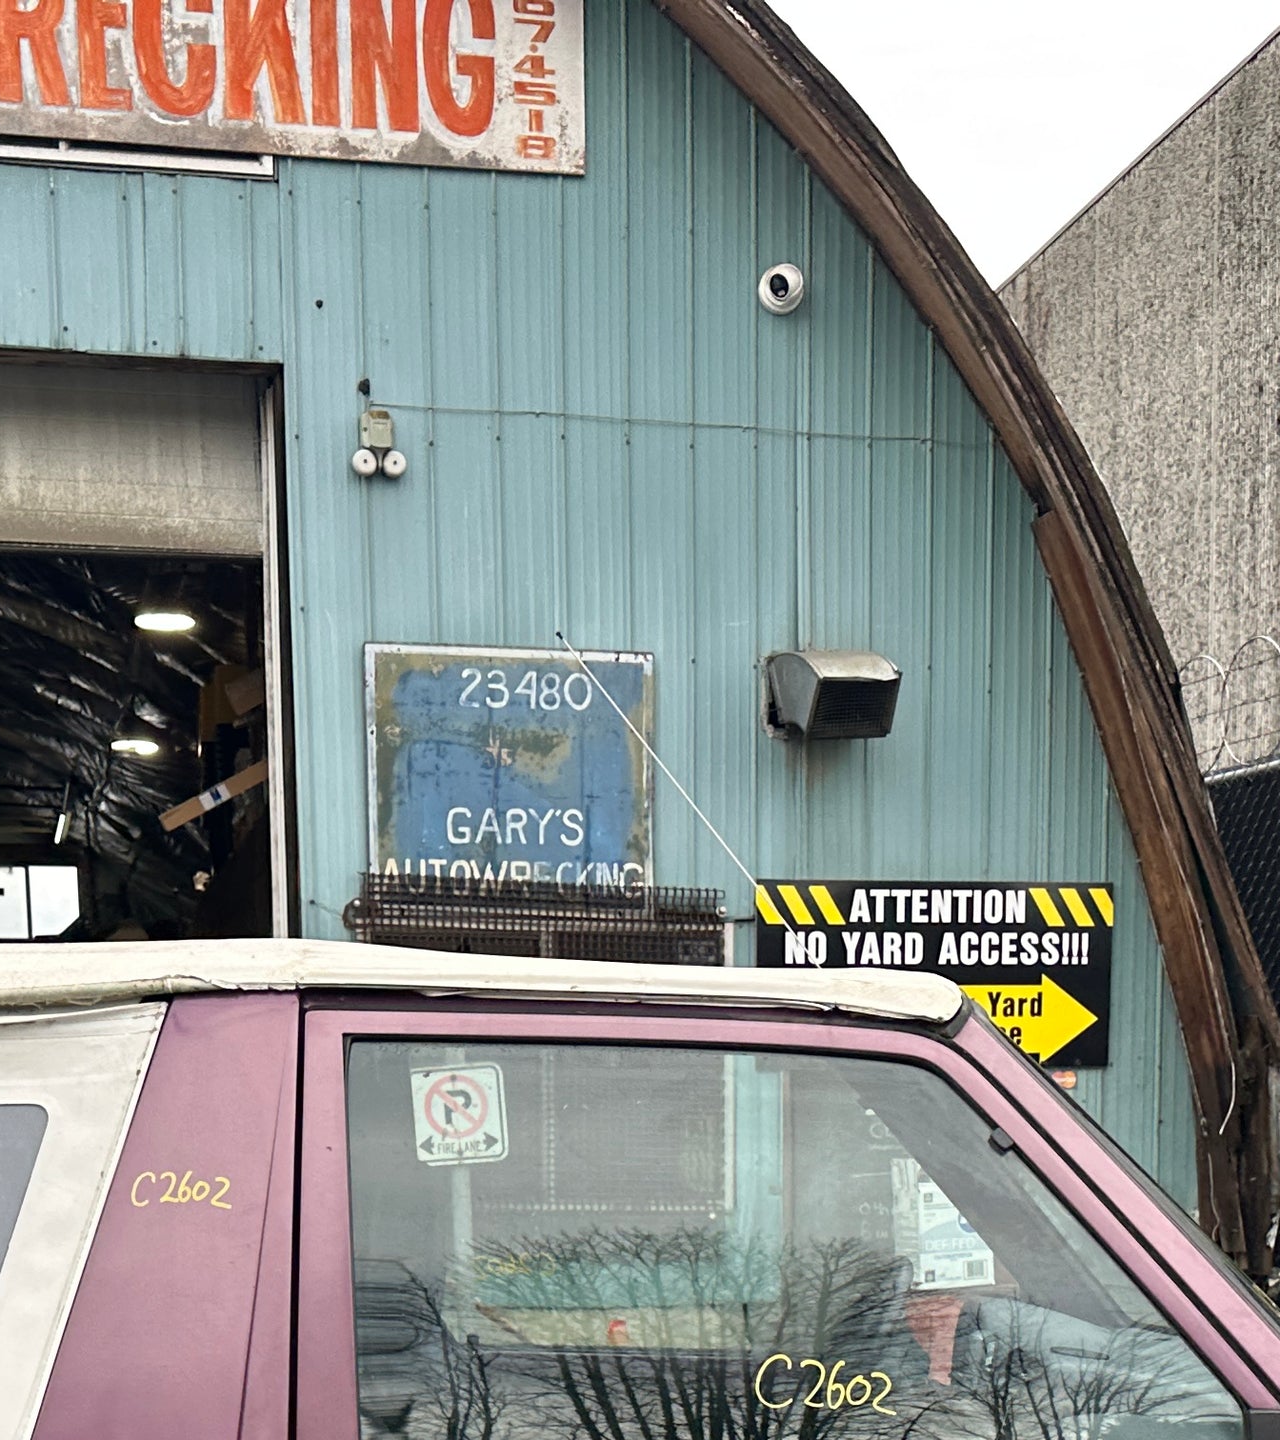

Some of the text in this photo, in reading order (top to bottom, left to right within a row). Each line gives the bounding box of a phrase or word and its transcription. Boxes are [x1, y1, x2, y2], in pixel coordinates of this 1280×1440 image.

[458, 667, 593, 711] 23480
[446, 806, 585, 847] GARY'S
[848, 888, 1026, 924] ATTENTION
[784, 930, 1089, 966] NO YARD ACCESS!!!
[987, 991, 1043, 1018] Yard
[130, 1170, 232, 1210] C2602
[754, 1353, 897, 1416] C2602
